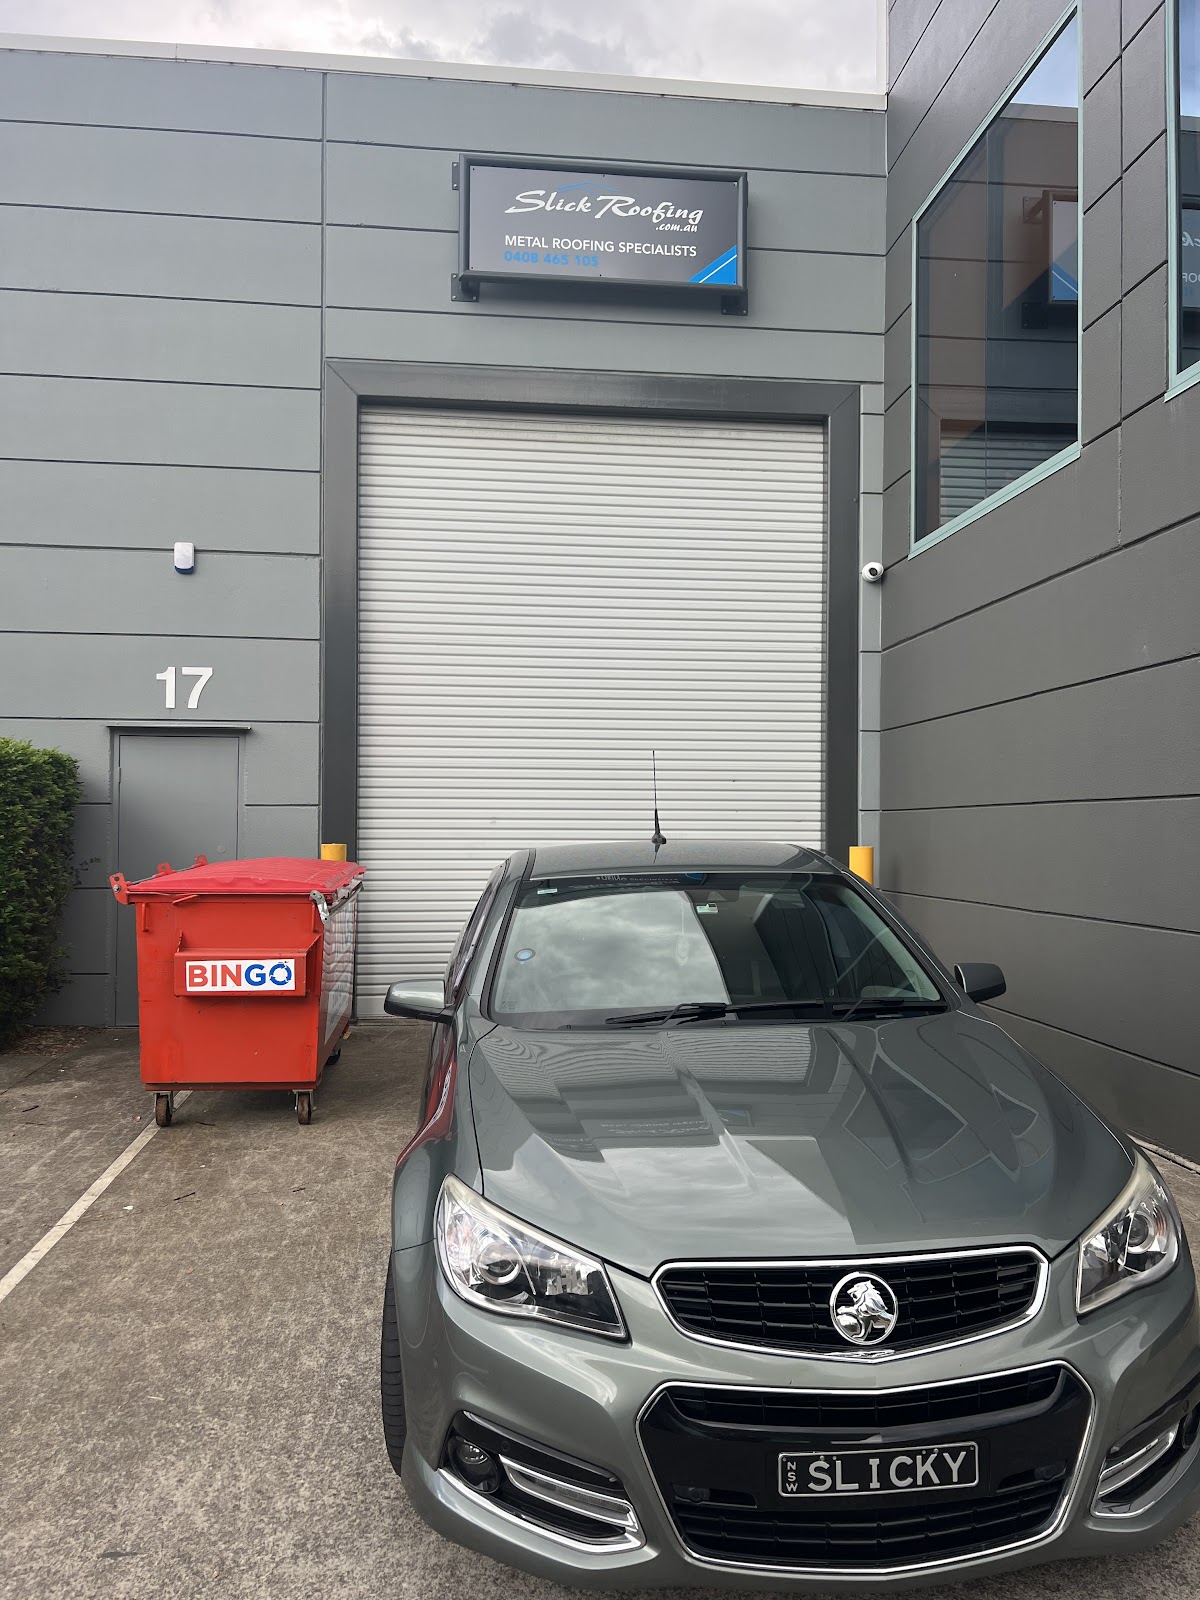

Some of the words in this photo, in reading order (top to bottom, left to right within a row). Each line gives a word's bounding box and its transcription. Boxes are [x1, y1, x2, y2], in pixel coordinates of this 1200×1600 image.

[504, 189, 592, 213] Slick
[594, 195, 704, 224] Roofing
[655, 223, 698, 232] .com.au
[503, 250, 539, 264] 0408
[543, 253, 569, 265] 465
[574, 255, 600, 267] 105
[504, 234, 549, 248] METAL
[552, 237, 615, 252] ROOFING
[618, 241, 697, 257] SPECIALISTS
[155, 666, 213, 709] 17
[188, 963, 293, 987] BINGO
[785, 1461, 798, 1493] NSW
[807, 1451, 967, 1491] SLICKY
